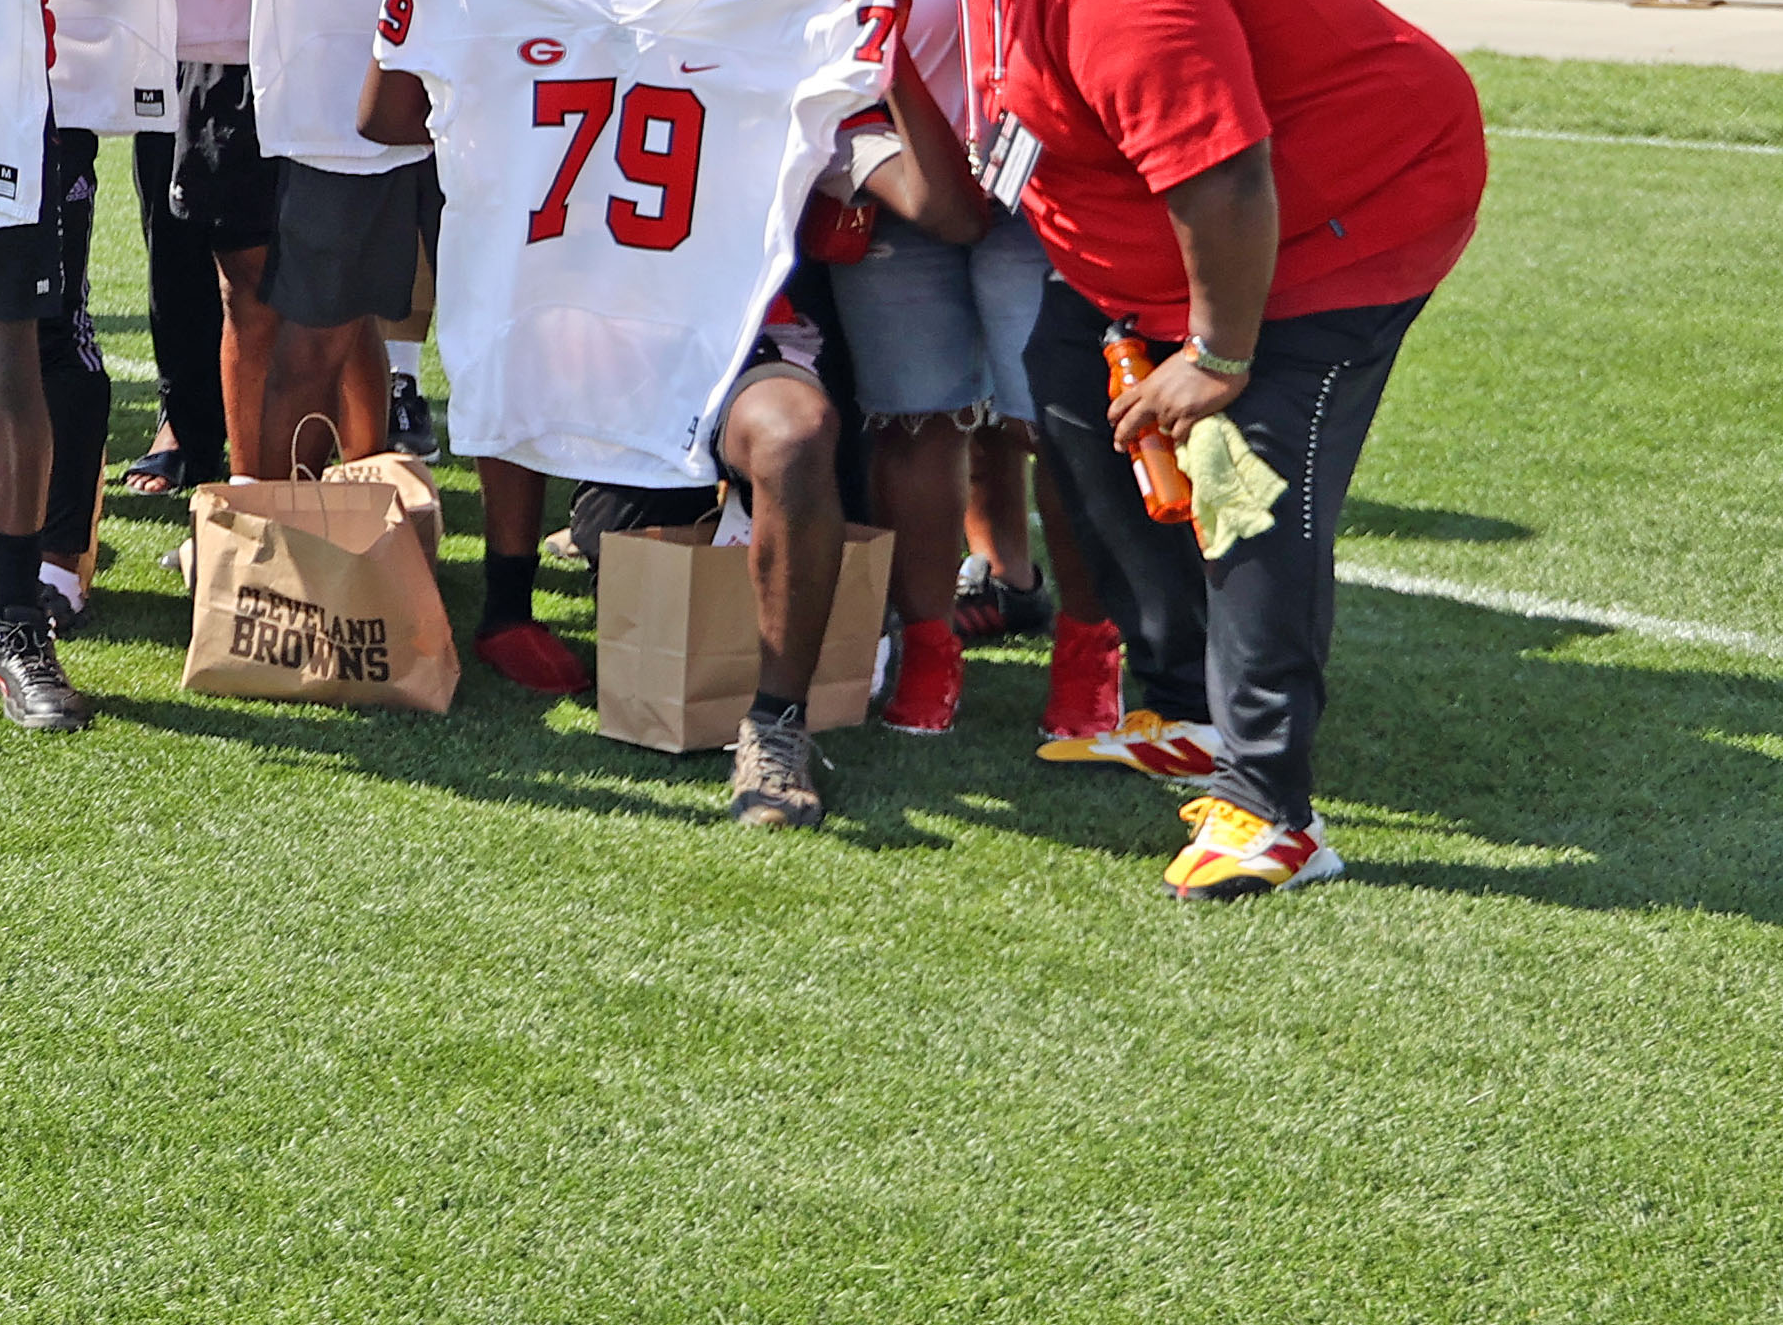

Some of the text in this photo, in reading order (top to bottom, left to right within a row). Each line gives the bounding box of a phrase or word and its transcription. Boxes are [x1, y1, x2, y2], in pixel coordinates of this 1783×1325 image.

[517, 38, 566, 66] G
[855, 6, 895, 63] 7
[0, 167, 12, 179] M
[525, 77, 706, 252] 79
[236, 585, 386, 645] CLEVELAND
[230, 615, 390, 683] BROWNS
